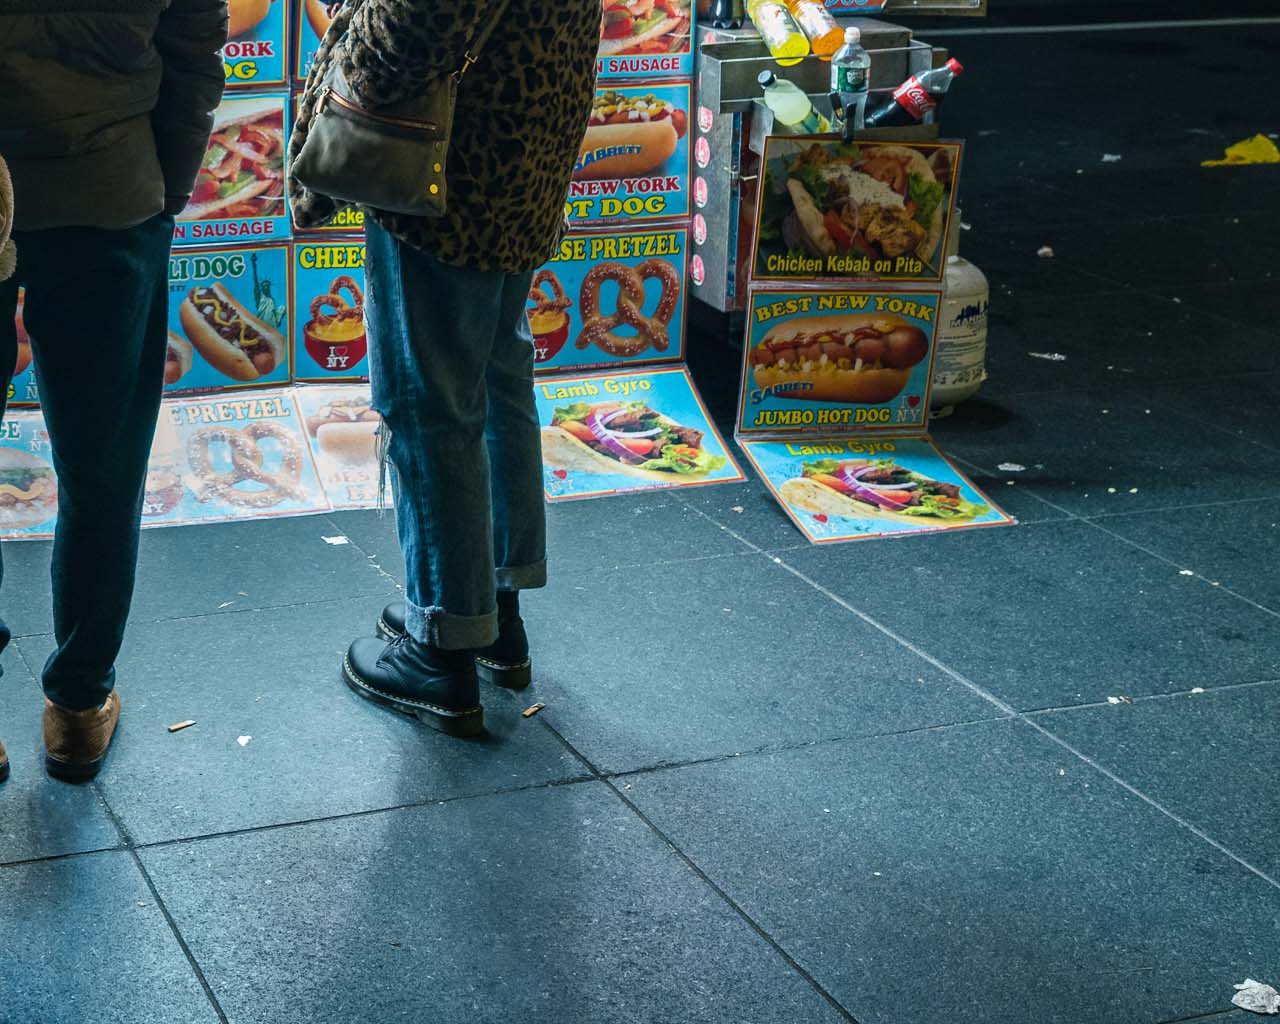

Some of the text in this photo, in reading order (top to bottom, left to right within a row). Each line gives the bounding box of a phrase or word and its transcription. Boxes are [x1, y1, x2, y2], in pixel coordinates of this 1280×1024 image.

[224, 42, 274, 58] ORK
[608, 57, 680, 73] SAUSAGE
[571, 176, 681, 197] NEW YORK
[599, 195, 666, 217] DOG
[192, 221, 274, 238] SAUSAGE
[589, 234, 681, 260] PRETZEL
[193, 255, 246, 279] DOG
[767, 255, 923, 274] Chicken Kebab on Pita
[755, 297, 813, 324] BEST
[817, 295, 871, 310] NEW
[874, 296, 936, 323] YORK
[326, 355, 349, 368] NY
[541, 378, 652, 400] Lamb Gyro
[750, 380, 814, 405] SABRETT
[187, 398, 290, 424] PRETZEL
[754, 408, 892, 426] JUMBO HOT DOG
[896, 409, 920, 423] NY
[786, 440, 896, 456] Lamb Gyro
